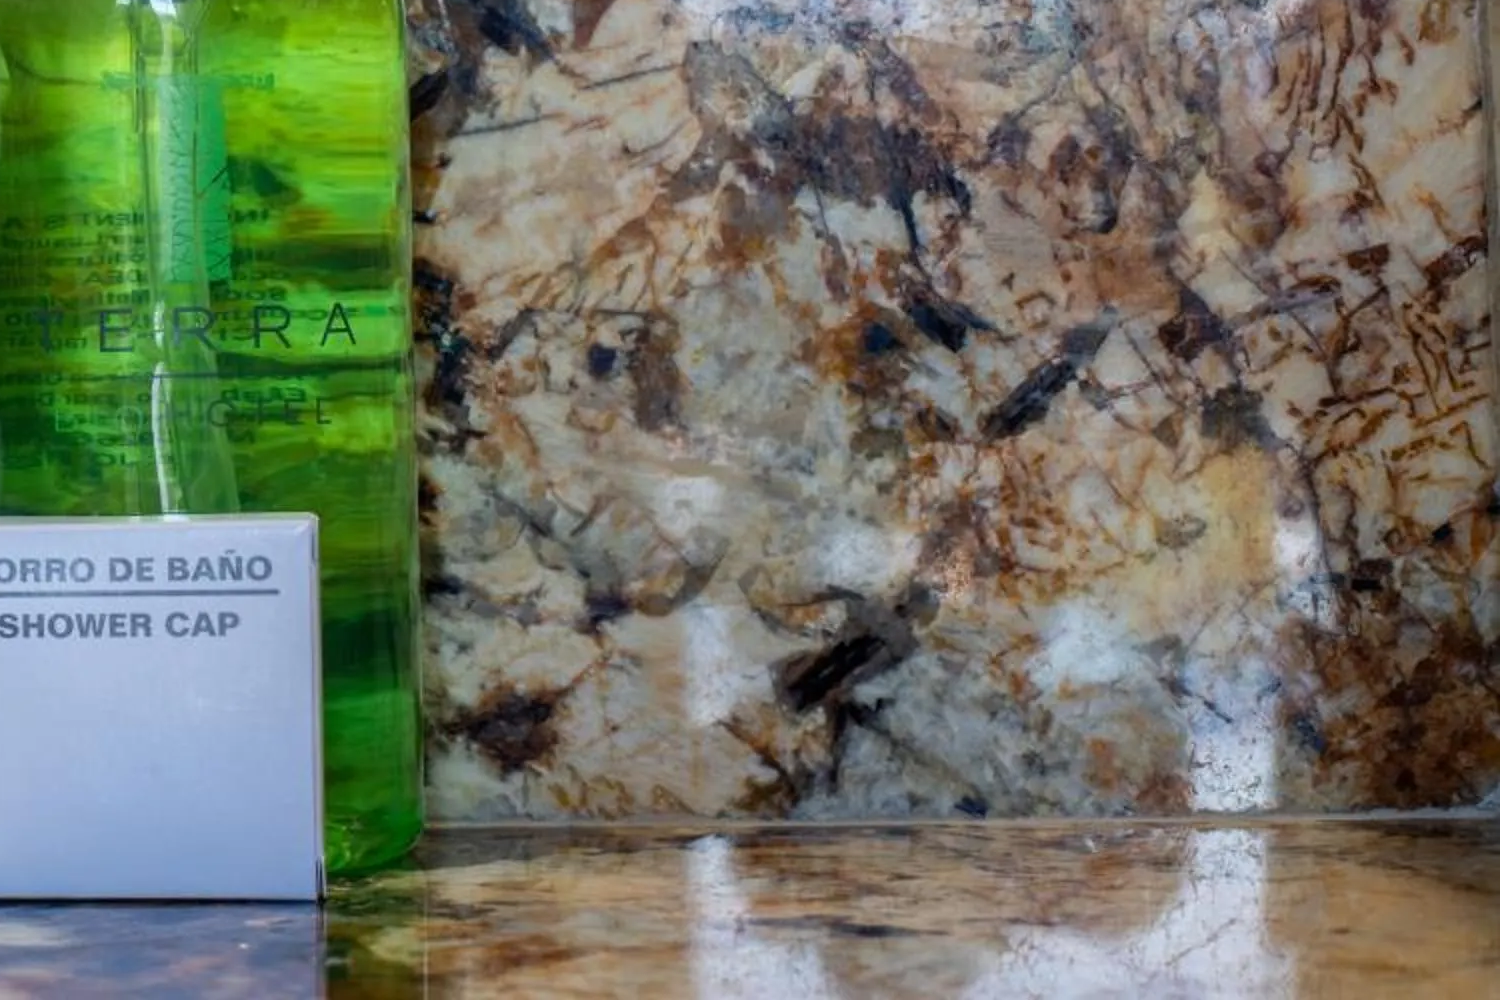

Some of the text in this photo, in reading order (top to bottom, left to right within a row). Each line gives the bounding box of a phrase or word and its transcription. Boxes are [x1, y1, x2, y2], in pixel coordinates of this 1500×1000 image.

[32, 302, 357, 353] TERRA
[108, 556, 156, 583] DE
[166, 549, 274, 583] BAÑO
[164, 610, 241, 638] CAP
